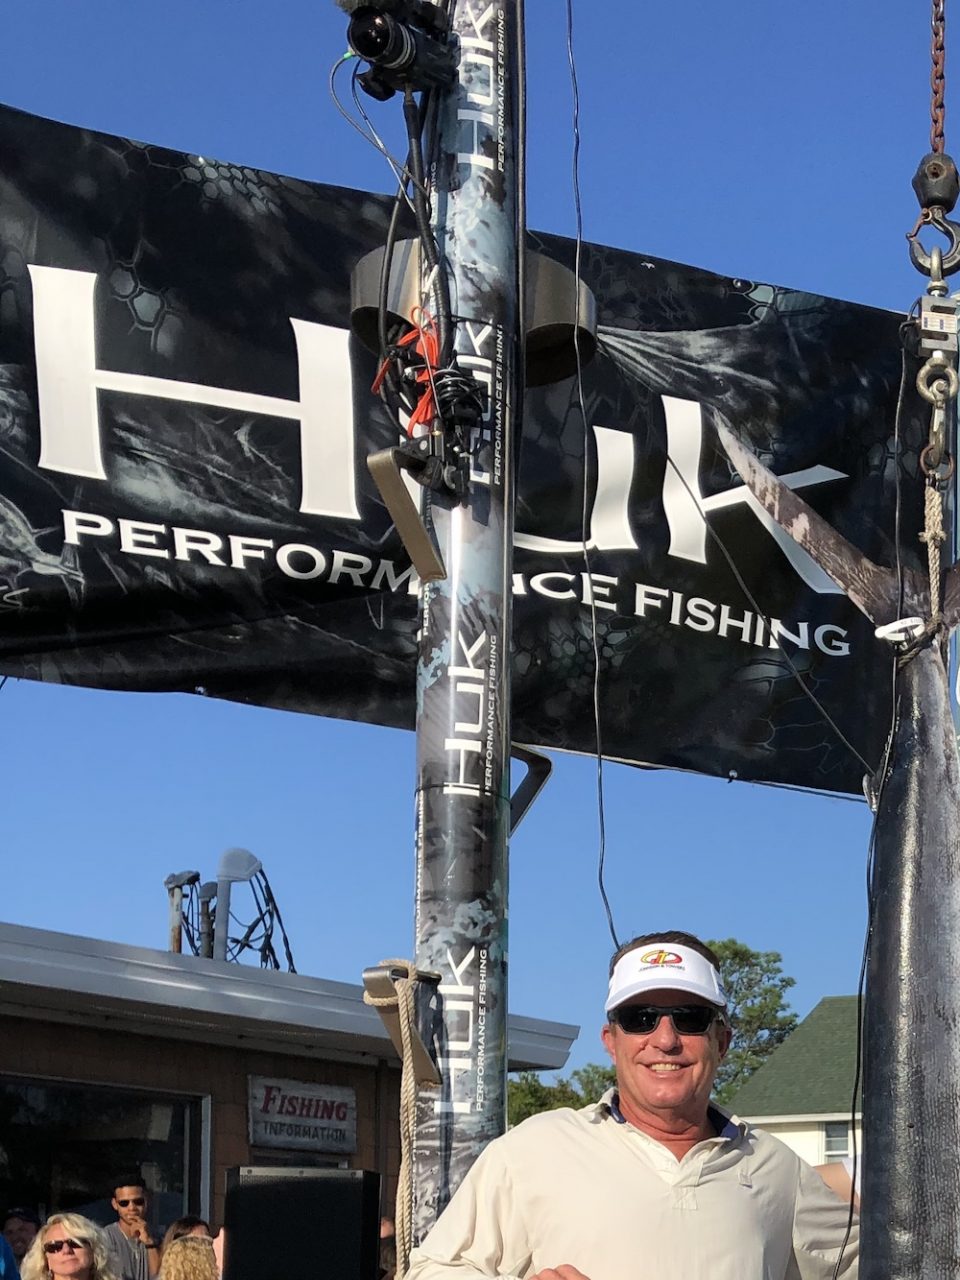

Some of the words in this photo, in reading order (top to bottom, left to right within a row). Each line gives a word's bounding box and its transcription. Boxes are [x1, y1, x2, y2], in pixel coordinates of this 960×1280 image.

[497, 8, 505, 63] FISHING
[496, 66, 505, 172] PERFORMANCE
[494, 382, 503, 485] PERFORMANCE
[61, 509, 619, 612] PERFORMCE
[634, 582, 851, 657] FISHING
[489, 634, 497, 689] FISHING
[484, 692, 495, 796] PERFORMANCE
[479, 948, 487, 1006] FISHING
[476, 1010, 486, 1112] PERFORMANCE
[260, 1085, 348, 1121] FISHING
[263, 1121, 346, 1141] INFORMATION
